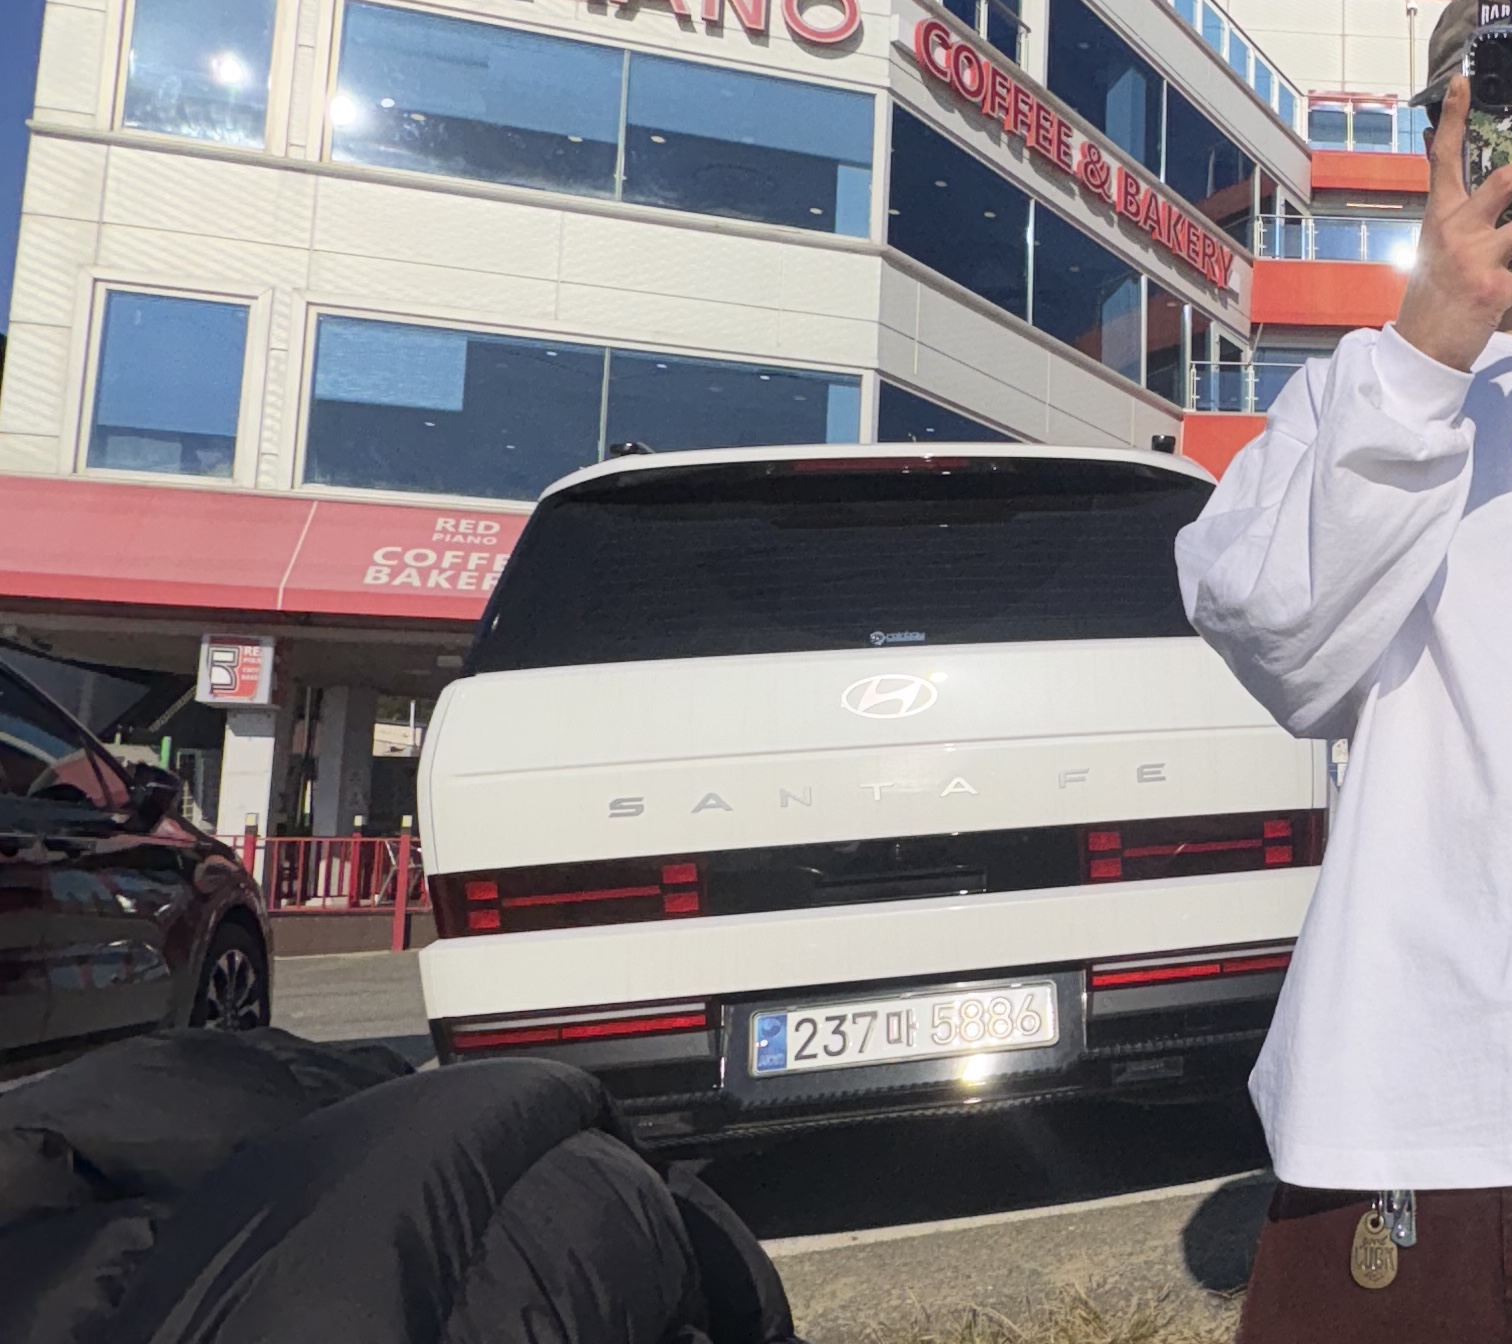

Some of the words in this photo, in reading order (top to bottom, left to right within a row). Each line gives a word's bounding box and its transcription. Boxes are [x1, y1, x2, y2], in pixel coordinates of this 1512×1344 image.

[915, 17, 1073, 175] COFFEE
[1077, 140, 1112, 203] &
[1116, 166, 1233, 288] BAKERY
[431, 532, 497, 546] PIANO
[435, 517, 500, 535] RED
[608, 776, 980, 819] SANTA
[1058, 762, 1166, 789] FE
[794, 1009, 919, 1062] 237마
[931, 993, 1042, 1046] 5886
